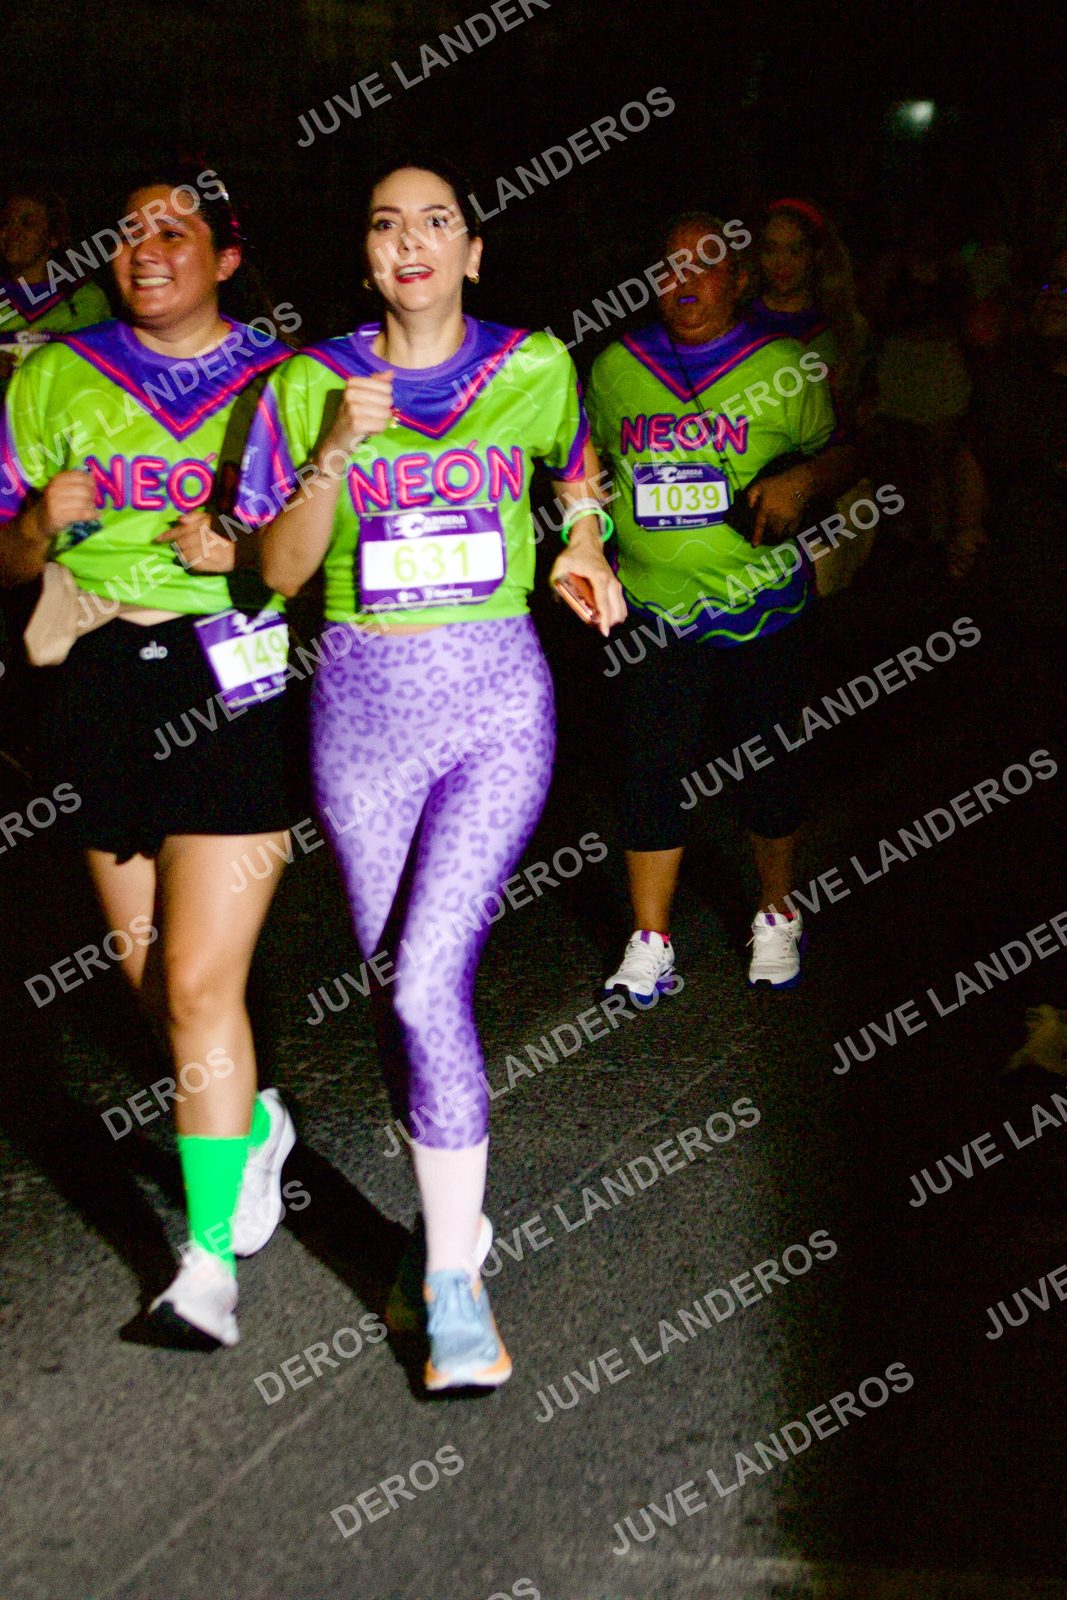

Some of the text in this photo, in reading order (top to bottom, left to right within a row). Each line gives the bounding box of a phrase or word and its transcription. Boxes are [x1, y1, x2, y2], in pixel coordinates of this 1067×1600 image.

[348, 439, 524, 517] NEÓN
[650, 484, 720, 512] 1039
[393, 539, 469, 582] 631
